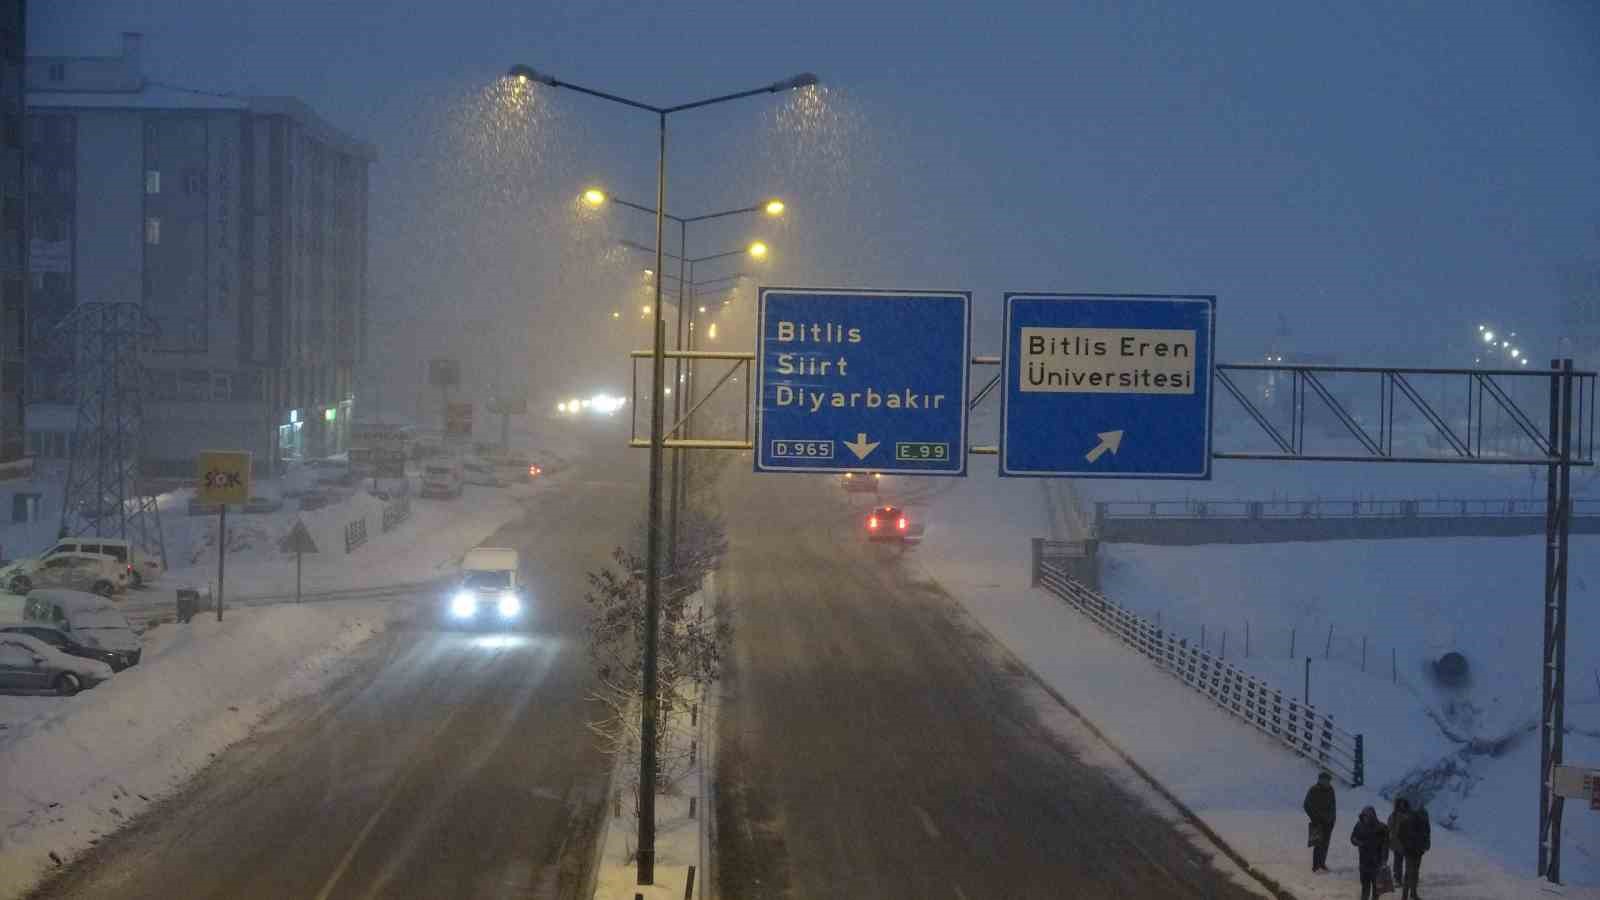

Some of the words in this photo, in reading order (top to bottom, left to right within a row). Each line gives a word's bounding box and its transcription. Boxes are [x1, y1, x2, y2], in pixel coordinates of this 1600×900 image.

[777, 320, 863, 344] Bitlis
[1029, 335, 1107, 357] Bitlis
[1120, 336, 1190, 358] Eren
[777, 353, 849, 377] Siirt
[1028, 361, 1192, 388] Üniversitesi
[776, 384, 946, 414] Diyarbakır
